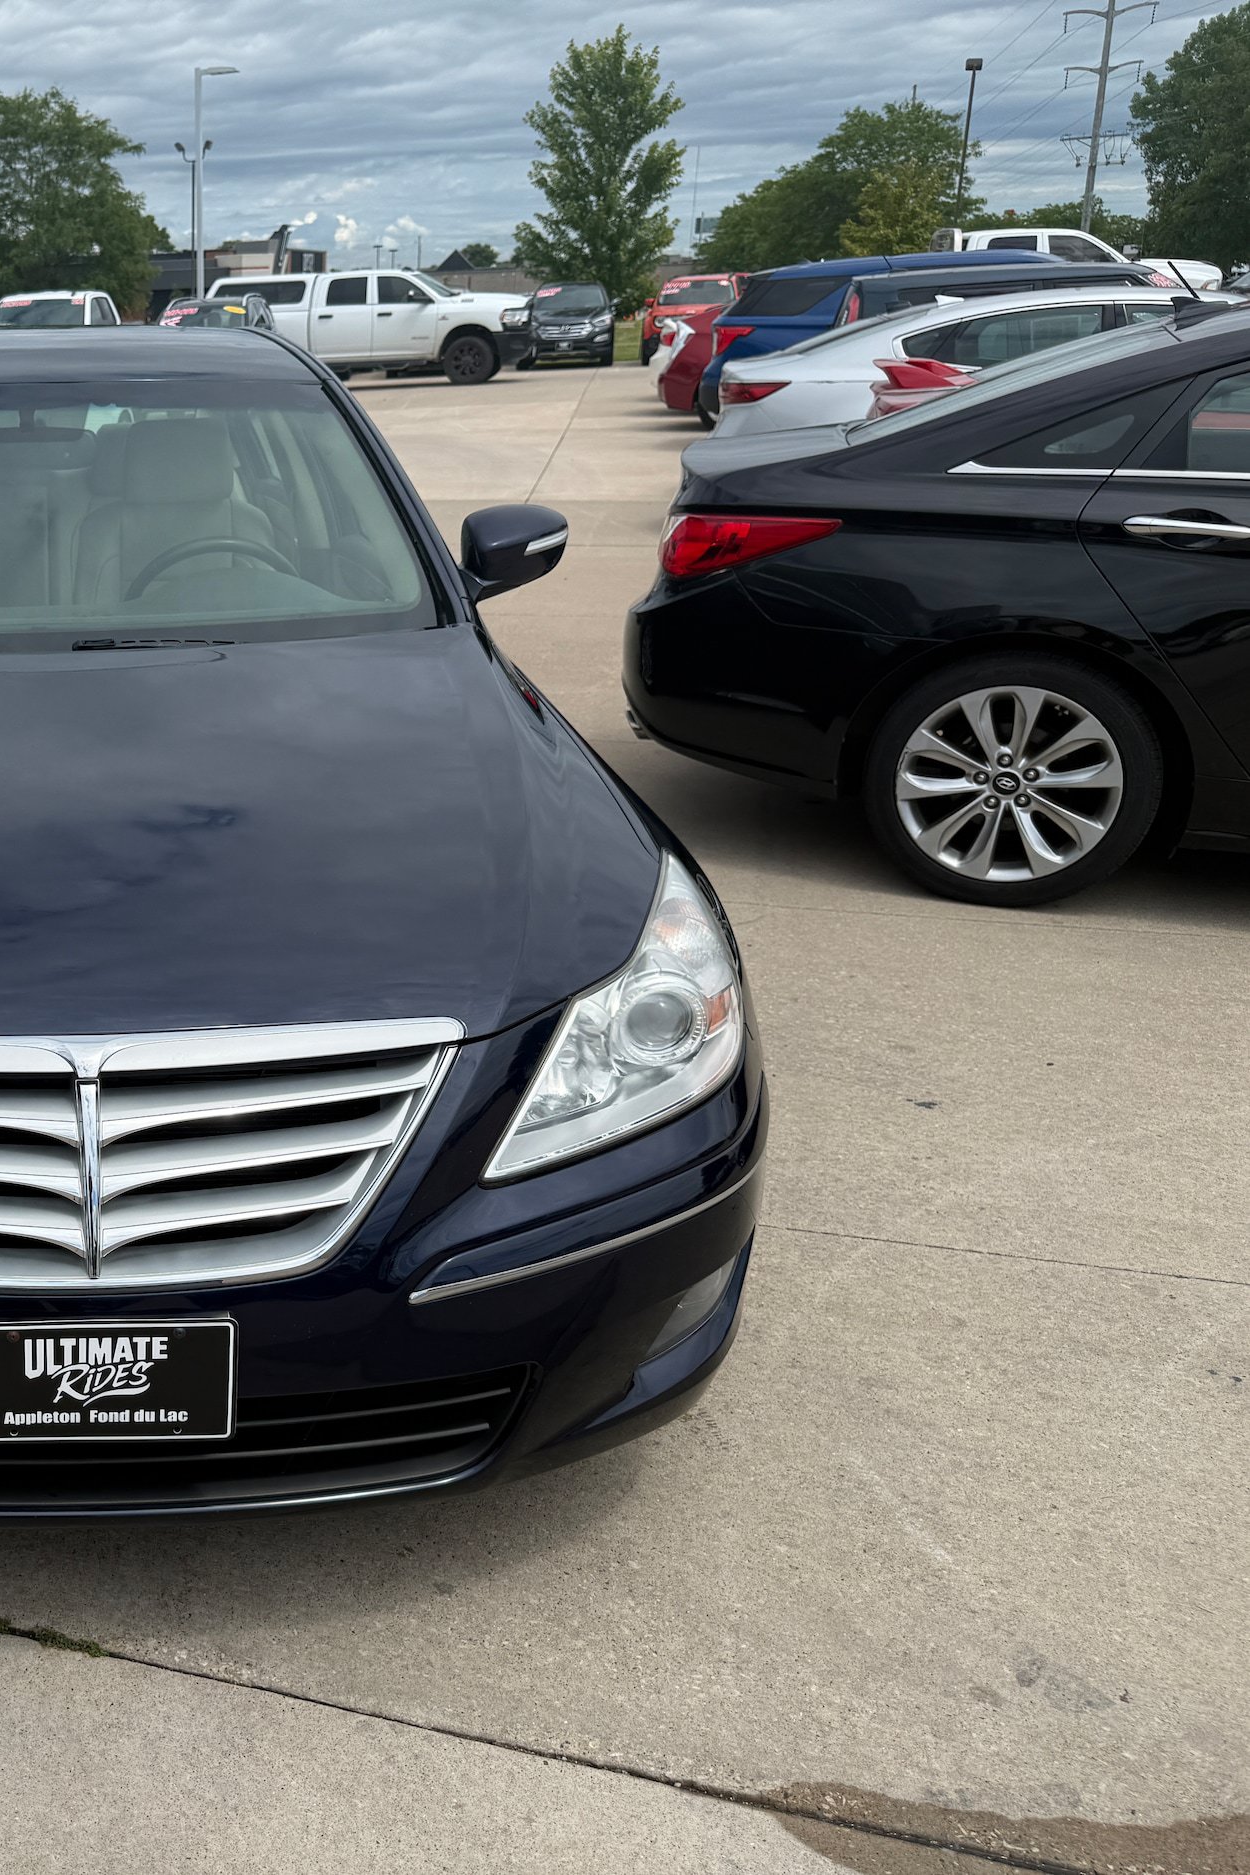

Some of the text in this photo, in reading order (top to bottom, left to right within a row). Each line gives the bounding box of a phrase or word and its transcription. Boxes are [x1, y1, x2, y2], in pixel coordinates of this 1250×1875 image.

[24, 1336, 168, 1380] ULTIMATE
[4, 1409, 189, 1426] Appleton Fond du Lac
